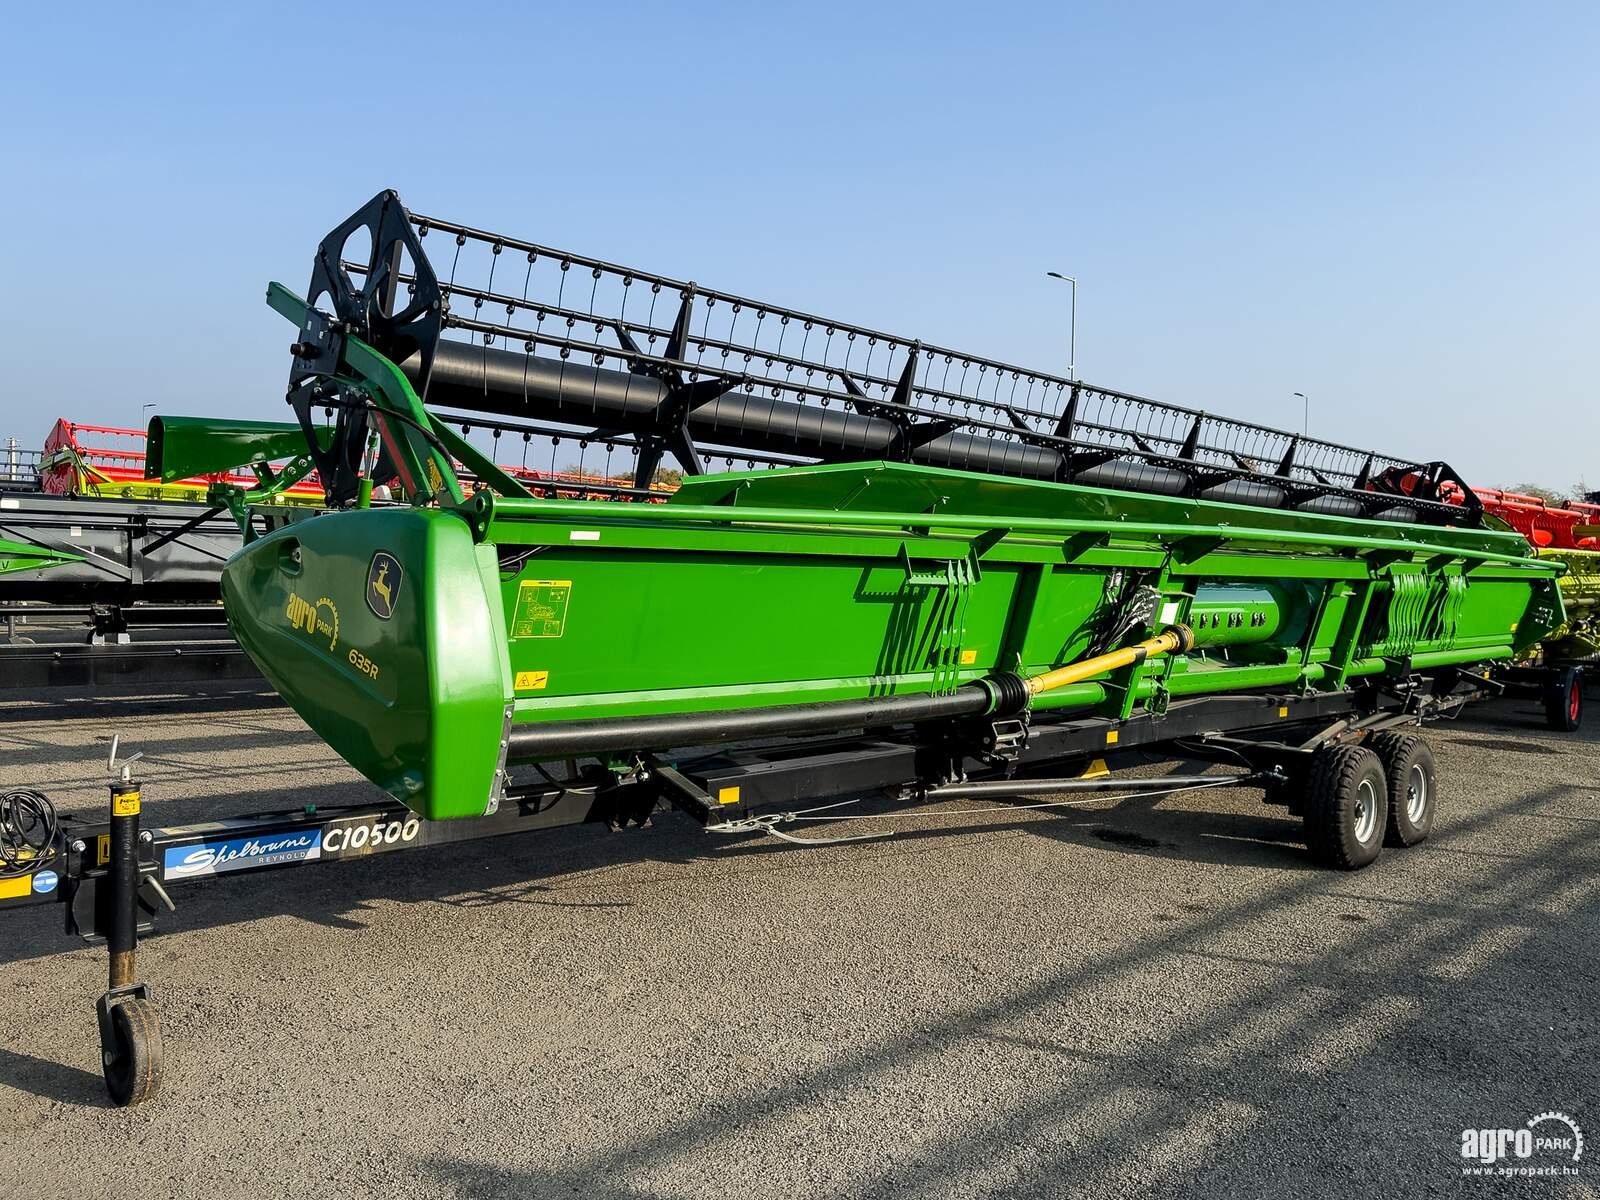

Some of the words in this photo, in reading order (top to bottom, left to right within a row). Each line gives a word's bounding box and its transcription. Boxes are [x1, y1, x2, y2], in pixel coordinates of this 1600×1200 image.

[286, 592, 317, 634] agro
[316, 619, 333, 638] PARK
[348, 648, 379, 680] 635R
[322, 818, 420, 853] C10500
[175, 836, 311, 874] Shelbourne
